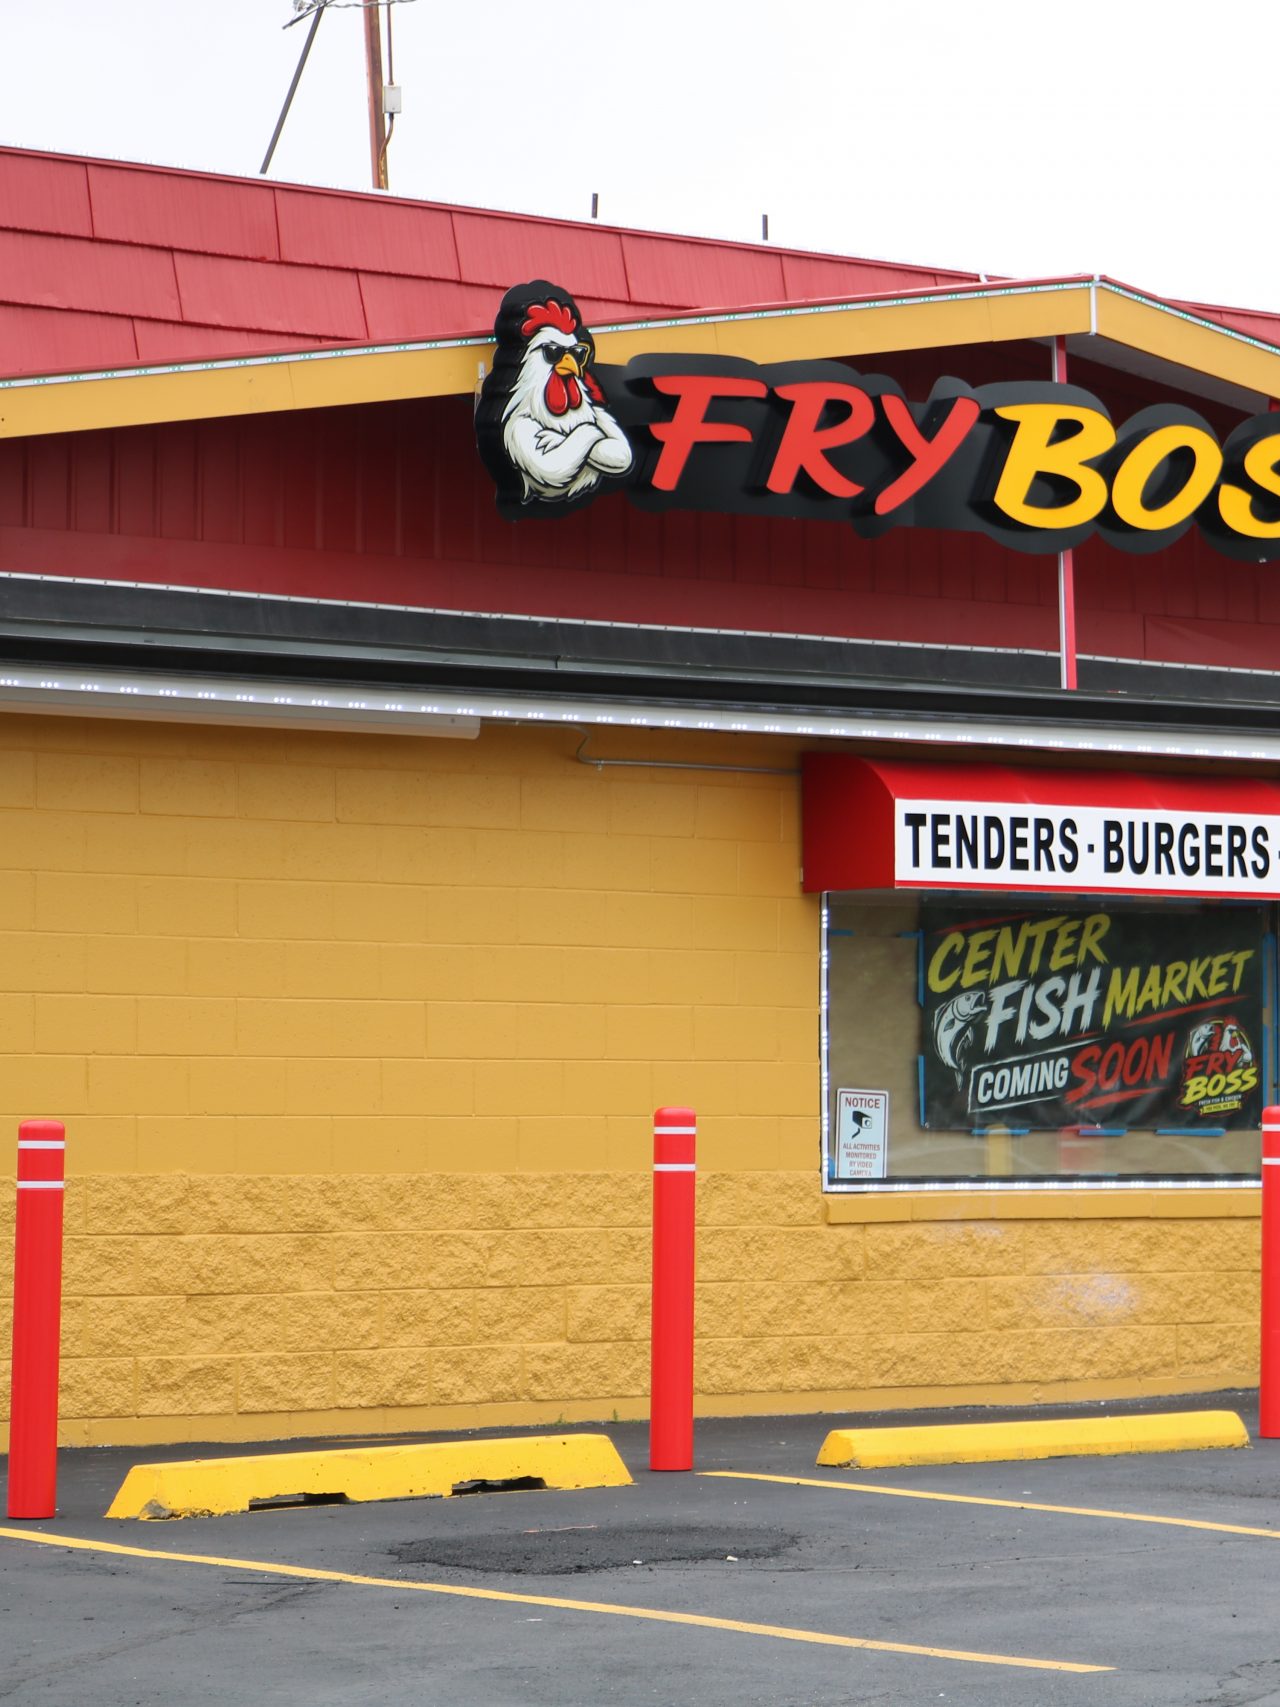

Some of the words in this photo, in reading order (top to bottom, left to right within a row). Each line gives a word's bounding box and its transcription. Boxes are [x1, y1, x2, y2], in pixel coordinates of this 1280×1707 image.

[651, 374, 980, 516] FRY
[904, 813, 1081, 873] TENDERS
[1103, 820, 1270, 879] BURGERS
[927, 913, 1111, 993] CENTER
[983, 967, 1103, 1055] FISH
[1103, 949, 1254, 1032] MARKET
[976, 1057, 1070, 1105] COMING
[1065, 1032, 1177, 1101] SOON
[1180, 1066, 1258, 1106] BOSS
[1186, 1049, 1242, 1081] FRY
[845, 1097, 880, 1109] NOTICE
[846, 1151, 877, 1160] MONITORED
[853, 1143, 880, 1151] ACTIVITIES
